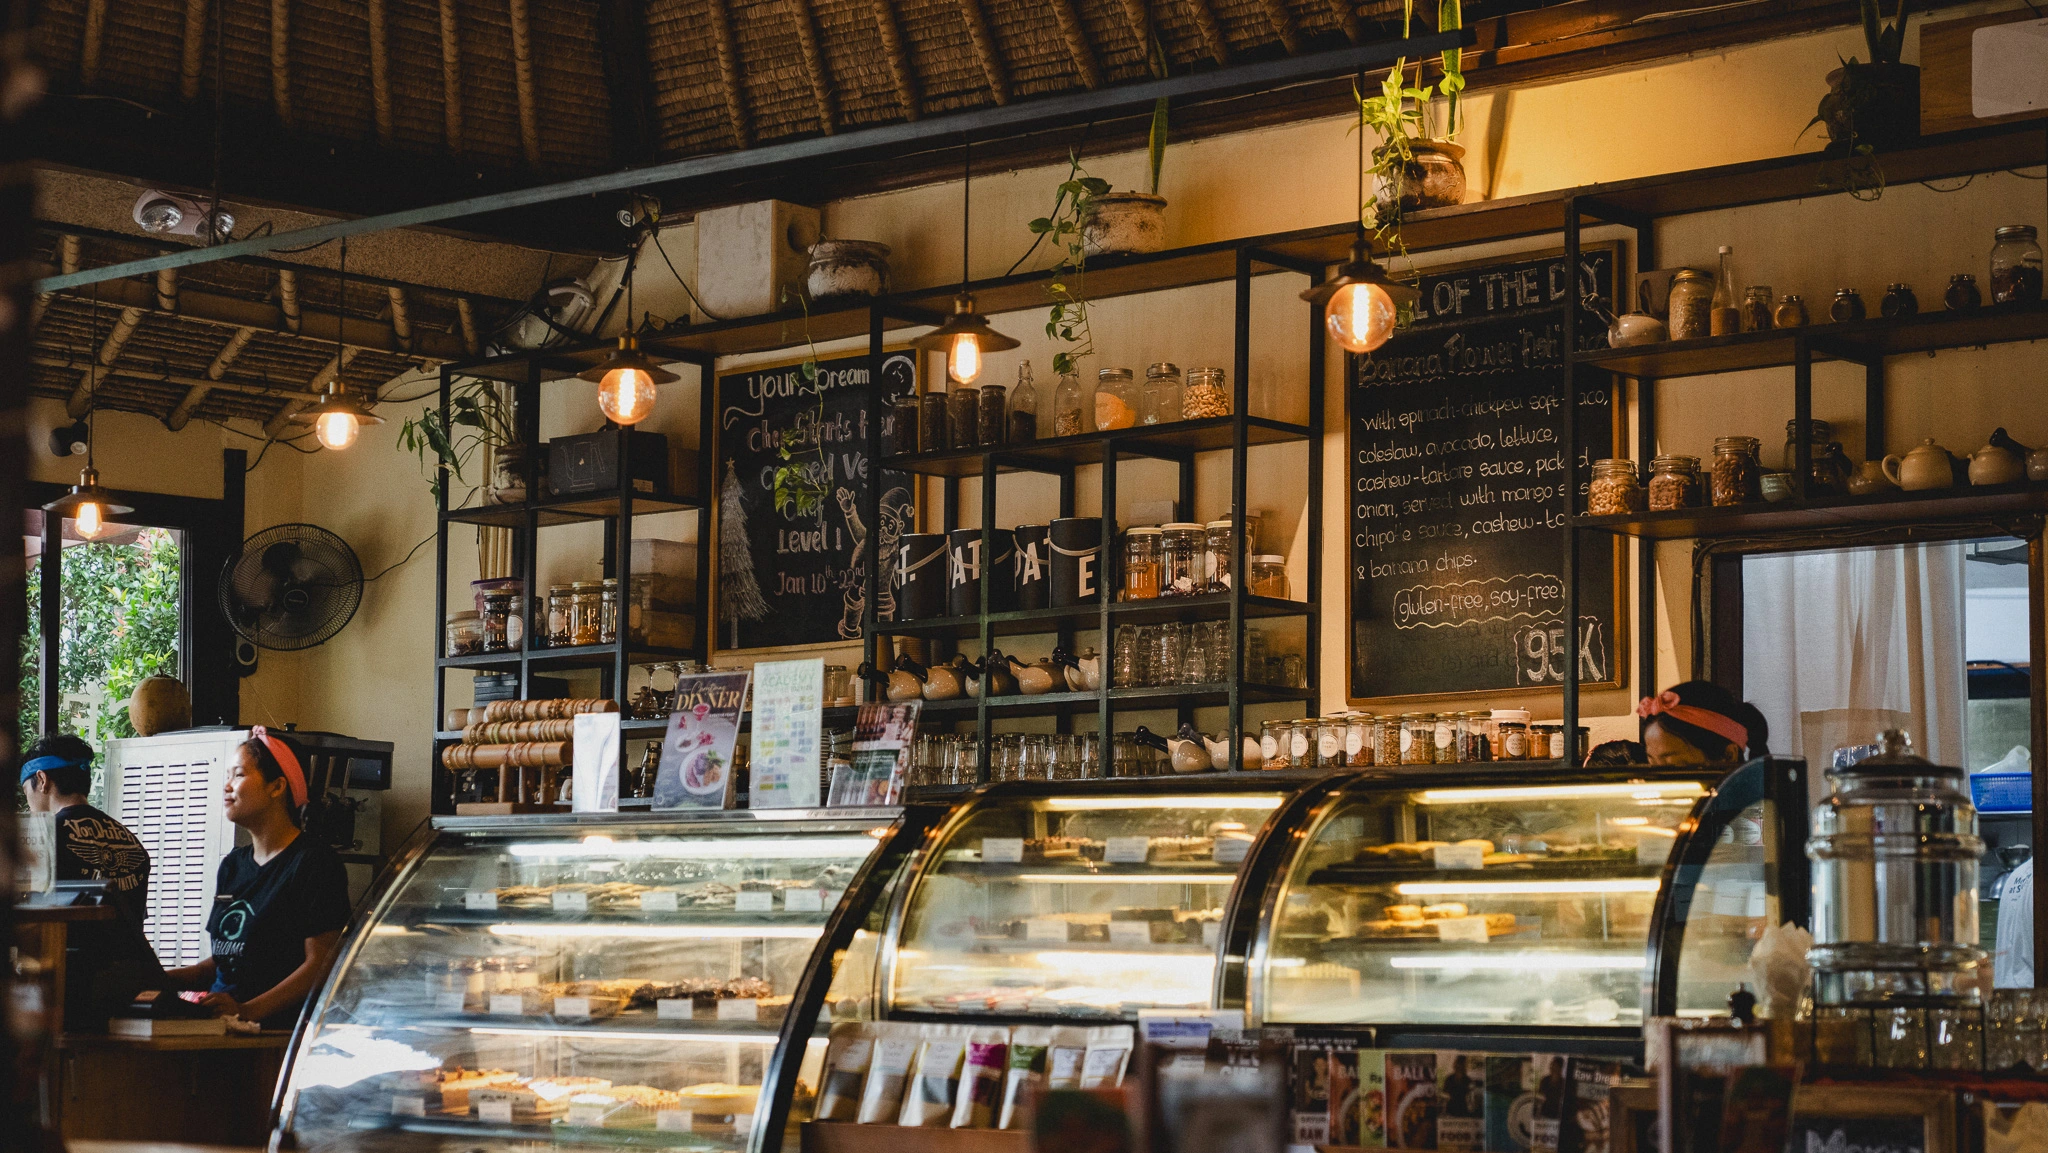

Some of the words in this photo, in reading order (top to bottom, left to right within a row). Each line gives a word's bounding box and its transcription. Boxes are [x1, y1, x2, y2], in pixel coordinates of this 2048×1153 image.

[1433, 279, 1470, 315] OF
[1479, 267, 1539, 310] THE
[1550, 258, 1603, 302] DY
[814, 368, 870, 395] Dream
[1361, 408, 1396, 430] with
[1579, 390, 1608, 405] aco,
[748, 420, 787, 451] Che
[1359, 440, 1422, 464] coleslaw,
[1426, 432, 1495, 455] avocado,
[1500, 425, 1558, 448] lettuce,
[1358, 461, 1473, 492] cashew-tartare
[1480, 460, 1531, 476] sauce,
[1536, 447, 1589, 477] pickd
[1358, 503, 1398, 518] onion,
[1460, 484, 1495, 505] with
[1502, 486, 1553, 503] mango
[777, 520, 828, 554] Level
[1419, 522, 1468, 540] sauce,
[1357, 565, 1365, 580] &
[1371, 558, 1428, 578] banana
[1436, 550, 1478, 574] chips.
[774, 571, 806, 596] Jan
